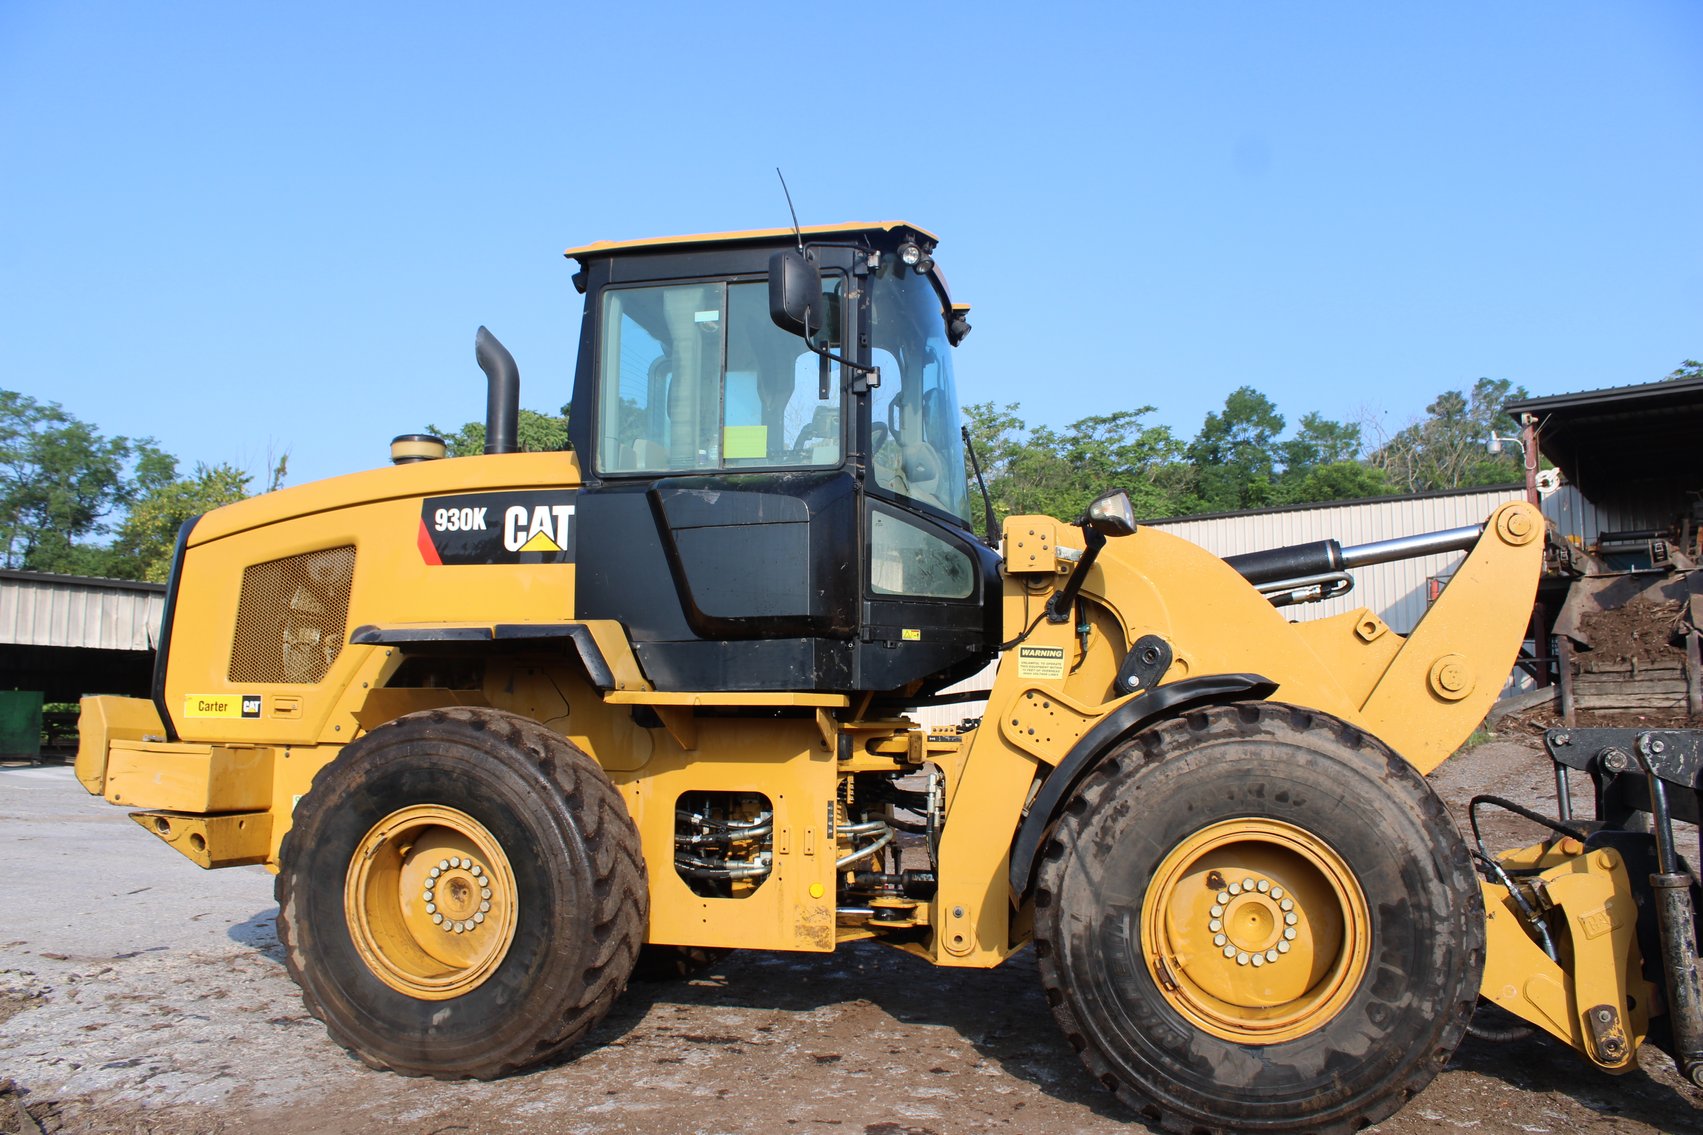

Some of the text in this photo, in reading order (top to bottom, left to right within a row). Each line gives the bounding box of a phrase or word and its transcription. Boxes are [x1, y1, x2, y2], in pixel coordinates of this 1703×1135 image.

[435, 504, 575, 552] 930K CAT
[1022, 649, 1062, 658] WARNING
[198, 700, 261, 713] Carter CAT
